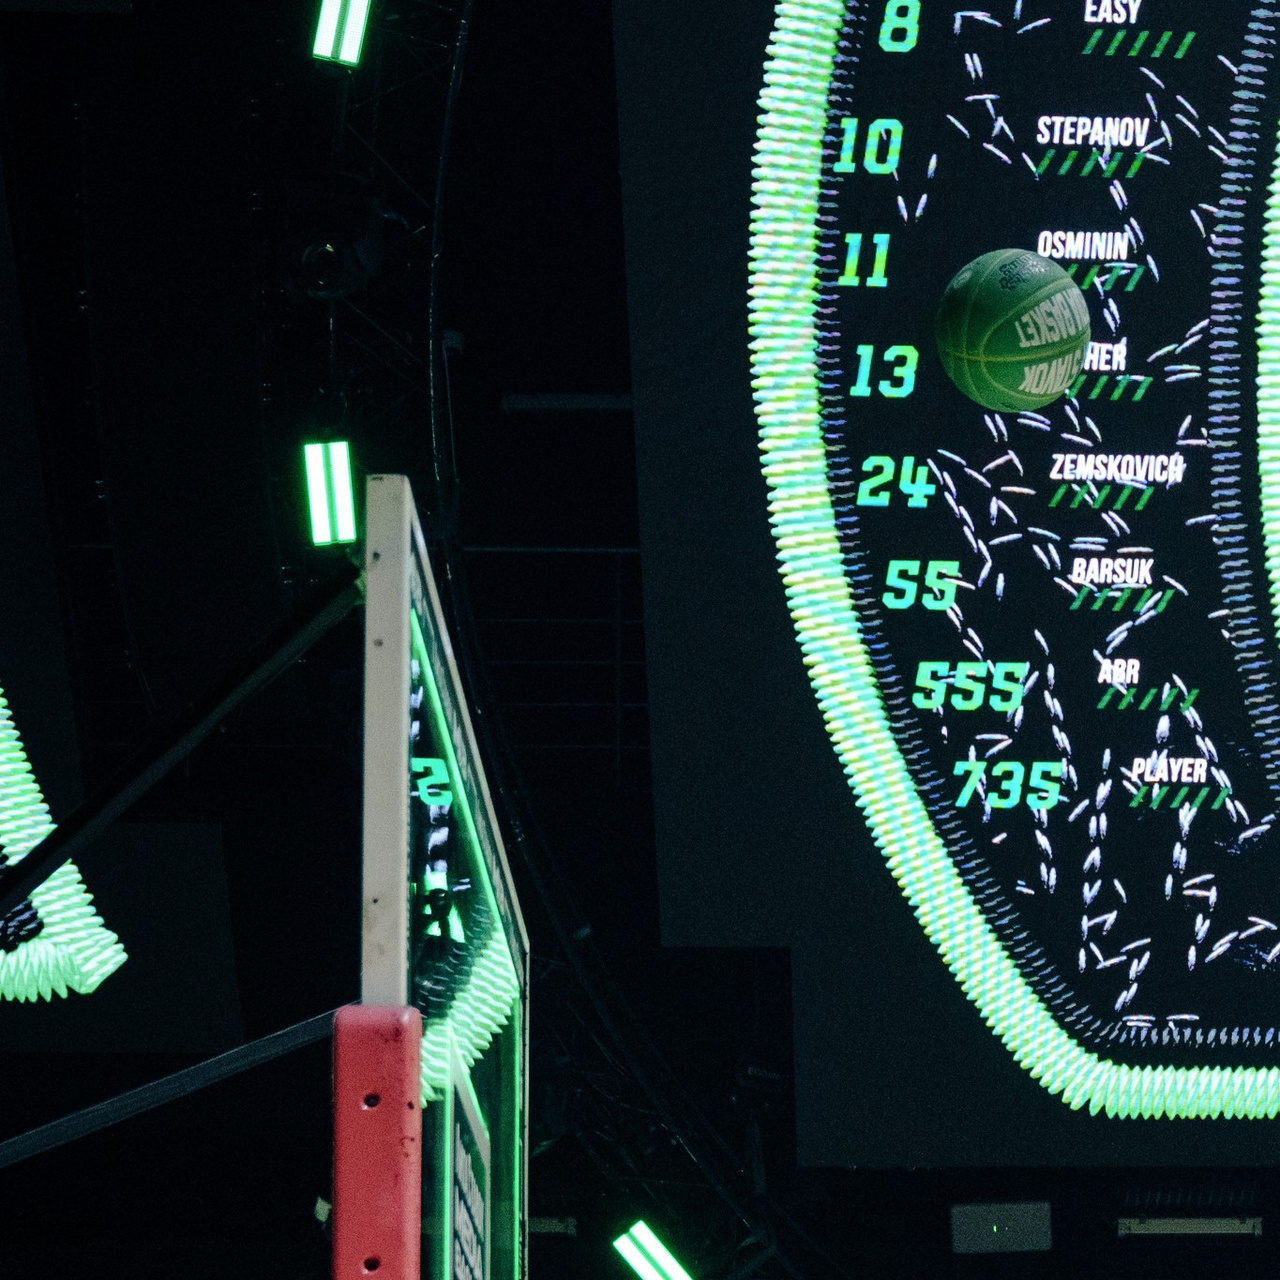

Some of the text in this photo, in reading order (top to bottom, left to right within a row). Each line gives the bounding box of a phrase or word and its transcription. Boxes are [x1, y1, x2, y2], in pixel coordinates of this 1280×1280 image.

[878, 0, 920, 52] 8
[1084, 0, 1141, 24] EASY
[834, 117, 904, 174] 10
[1037, 116, 1150, 147] STEPANOV
[838, 233, 890, 288] 11
[1037, 231, 1128, 260] OSMININ
[850, 345, 919, 399] 13
[856, 456, 937, 508] 24
[1050, 453, 1184, 484] ZEMSKOVICH
[883, 560, 960, 610] 55
[1072, 557, 1154, 585] BARSUK
[912, 662, 1027, 711] 555
[1098, 659, 1139, 684] ABR
[952, 761, 1064, 809] 735
[1131, 757, 1207, 784] PLAYER
